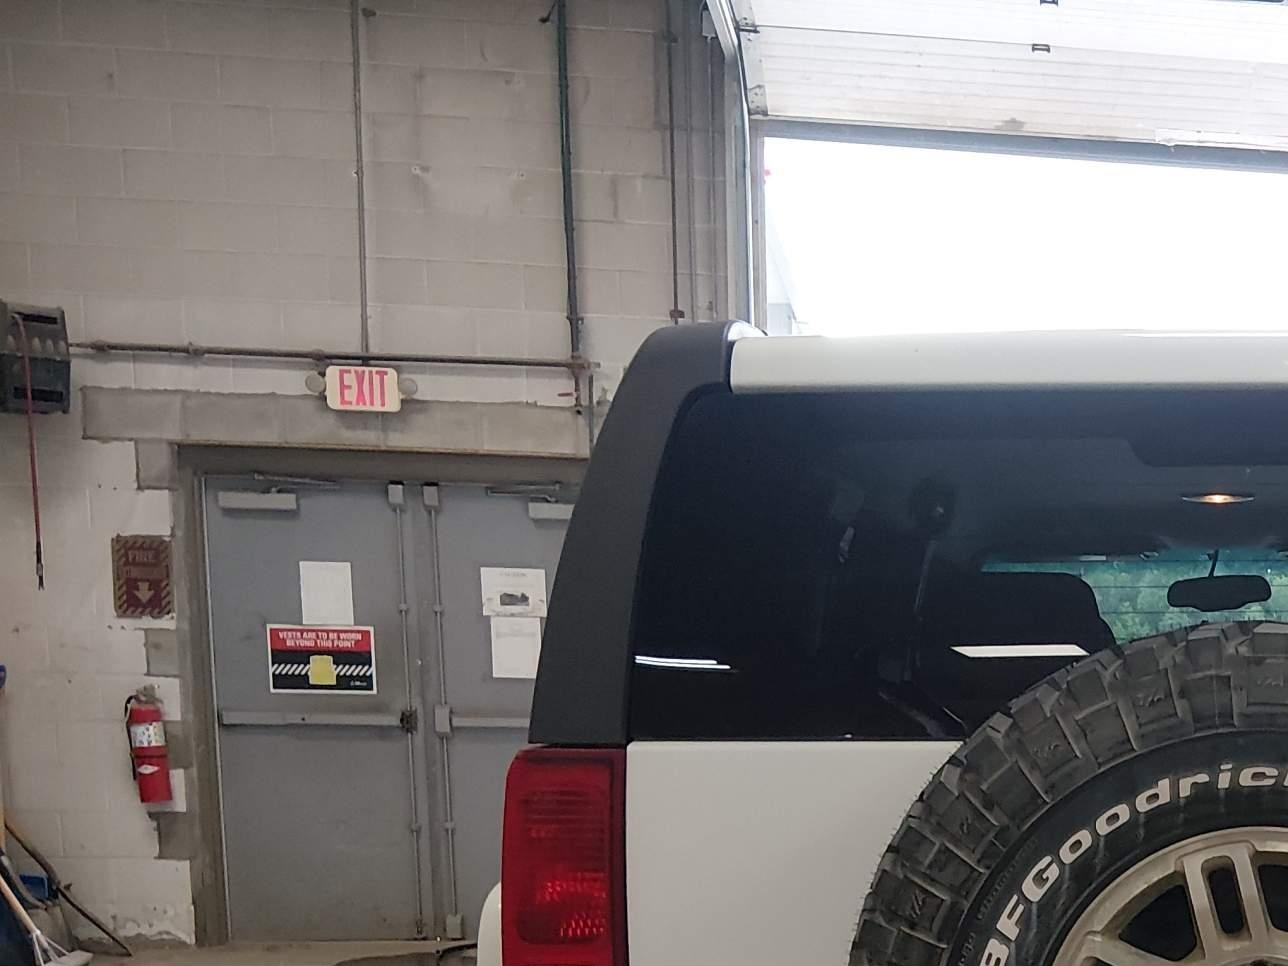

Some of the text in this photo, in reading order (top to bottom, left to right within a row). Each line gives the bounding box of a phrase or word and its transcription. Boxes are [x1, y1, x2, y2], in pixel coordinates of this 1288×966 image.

[338, 368, 388, 407] EXIT
[278, 631, 363, 641] VESTS ARE TO BE WORN
[286, 639, 356, 649] BEYOND THIS POINT
